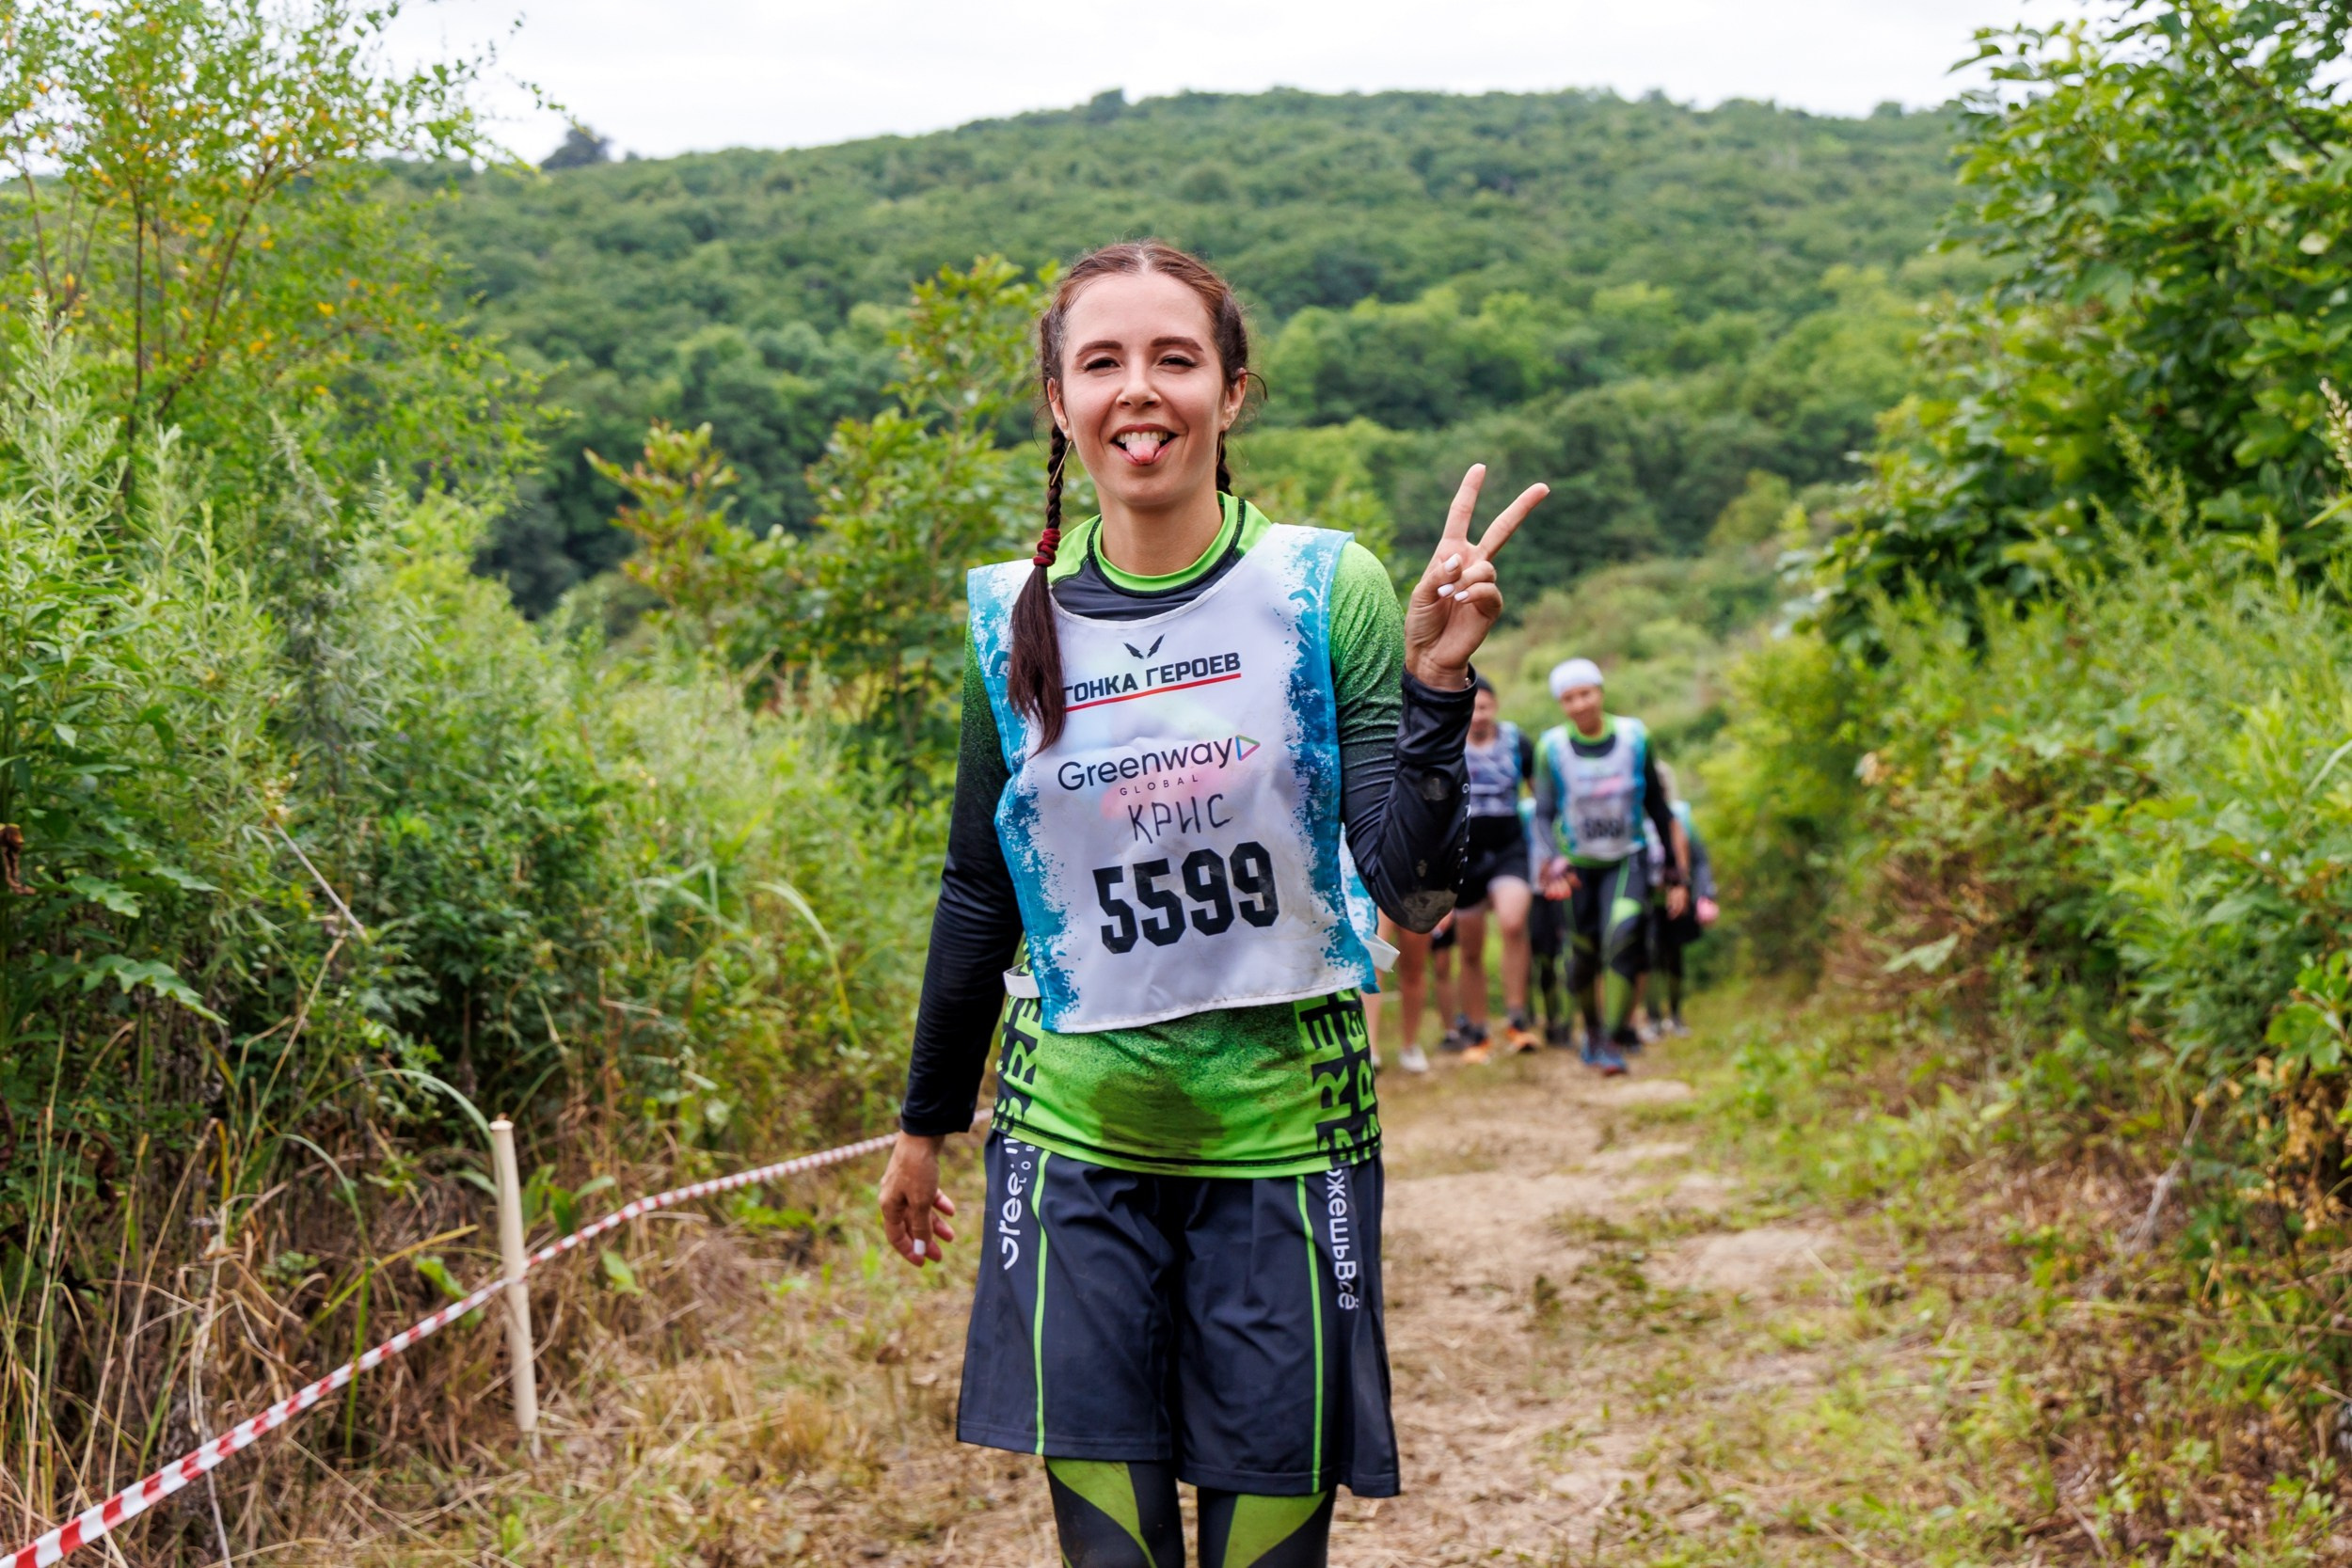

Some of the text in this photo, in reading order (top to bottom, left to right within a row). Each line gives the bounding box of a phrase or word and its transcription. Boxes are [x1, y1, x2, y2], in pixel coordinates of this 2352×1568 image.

[1145, 652, 1242, 688] ГЕРОЕВ
[1057, 737, 1233, 791] Greenway
[1120, 774, 1200, 796] GLOBAL
[1127, 793, 1234, 845] КРИС
[1091, 841, 1280, 955] 5599
